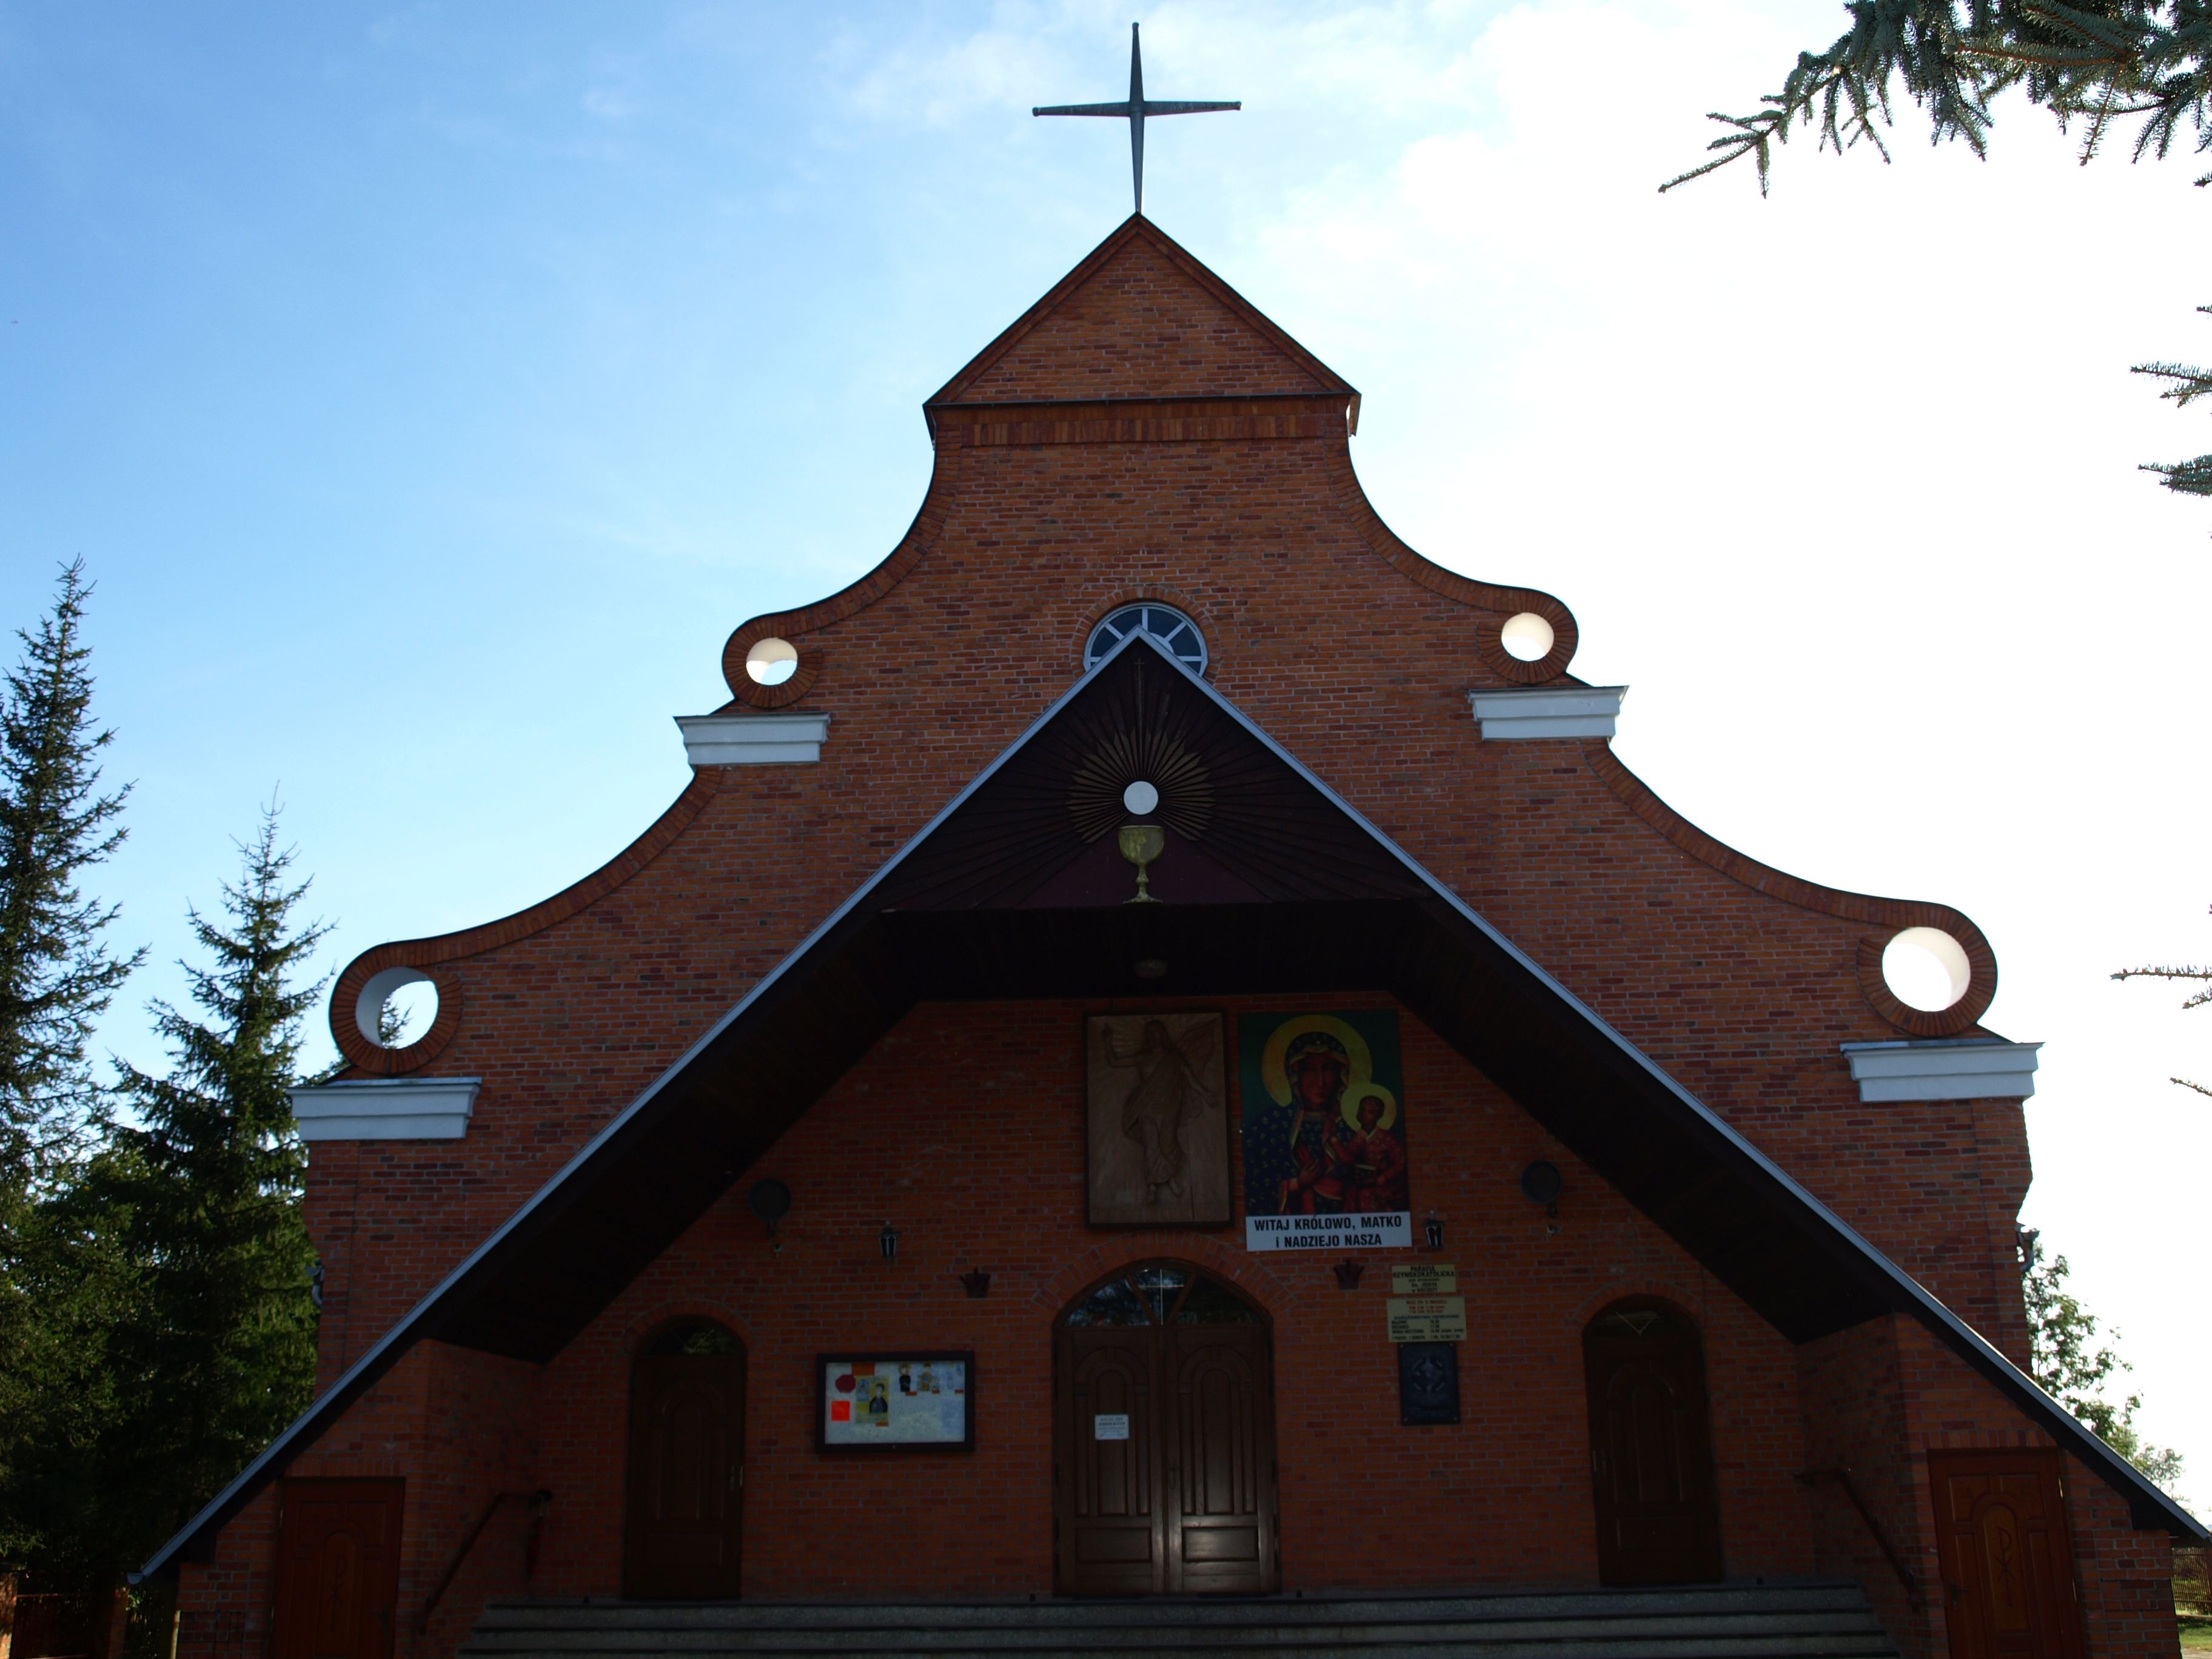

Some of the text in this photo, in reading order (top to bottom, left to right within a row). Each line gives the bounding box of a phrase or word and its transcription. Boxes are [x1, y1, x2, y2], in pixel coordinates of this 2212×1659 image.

[1255, 1216, 1401, 1231] WITAJ KRÓLOWO, MATKO
[1276, 1234, 1381, 1248] i NADZIEJO NASZA
